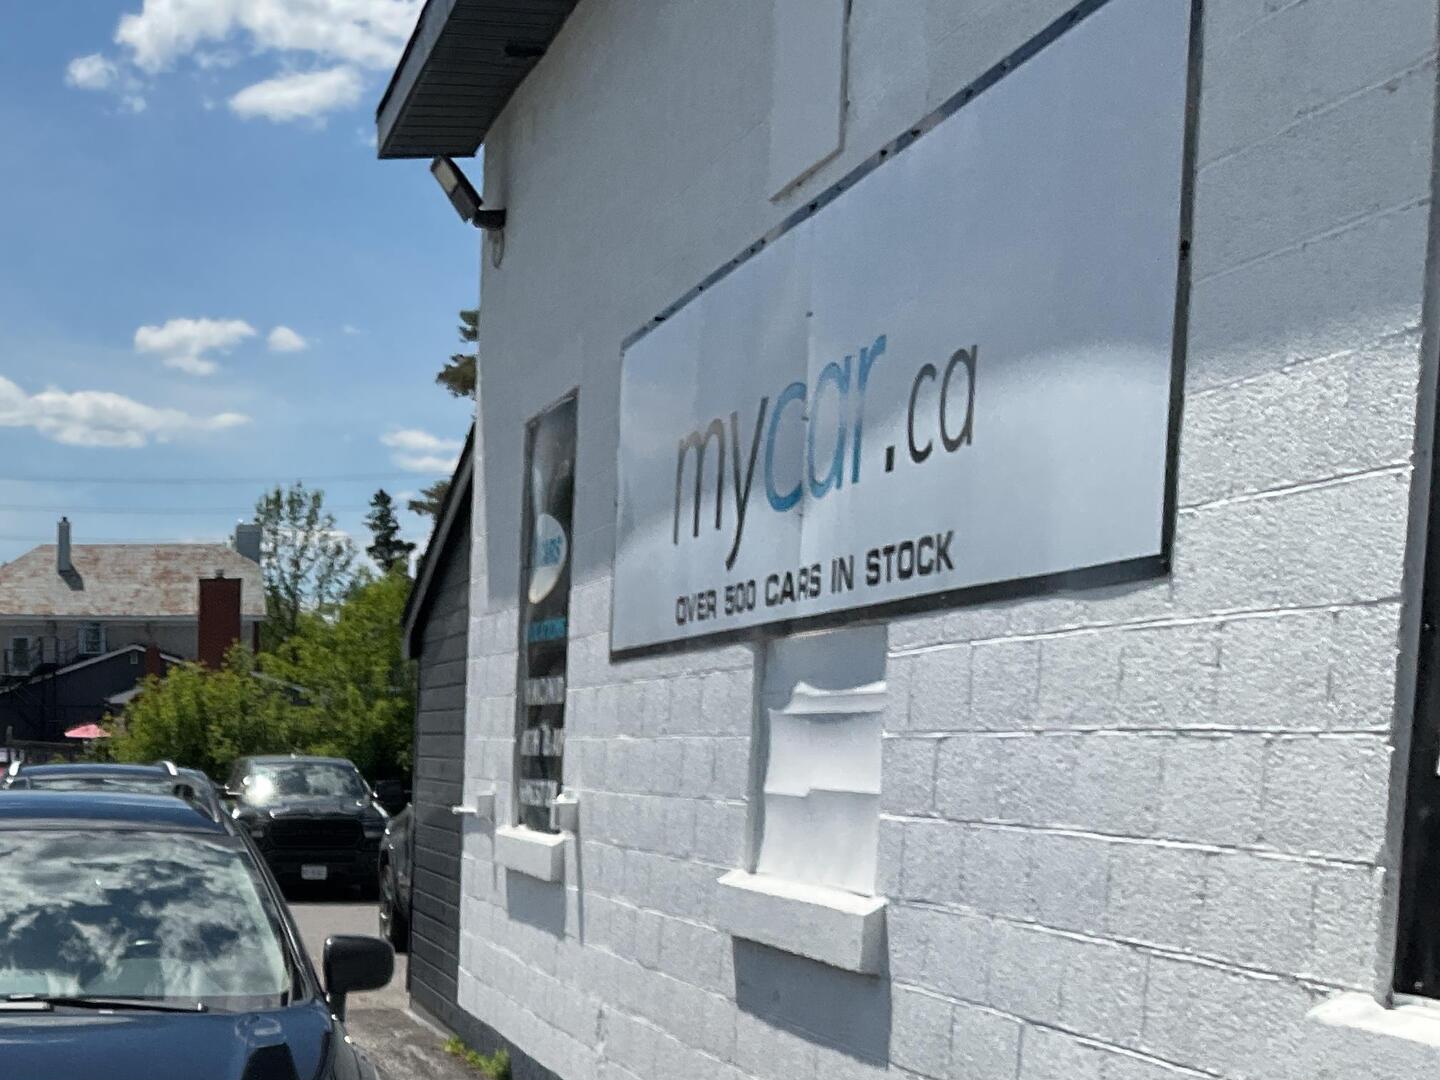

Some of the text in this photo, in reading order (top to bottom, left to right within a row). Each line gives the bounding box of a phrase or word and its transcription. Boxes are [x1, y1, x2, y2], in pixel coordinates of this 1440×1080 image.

[672, 334, 978, 571] mycar.ca
[675, 530, 955, 626] OVER 500 CARS IN STOCK
